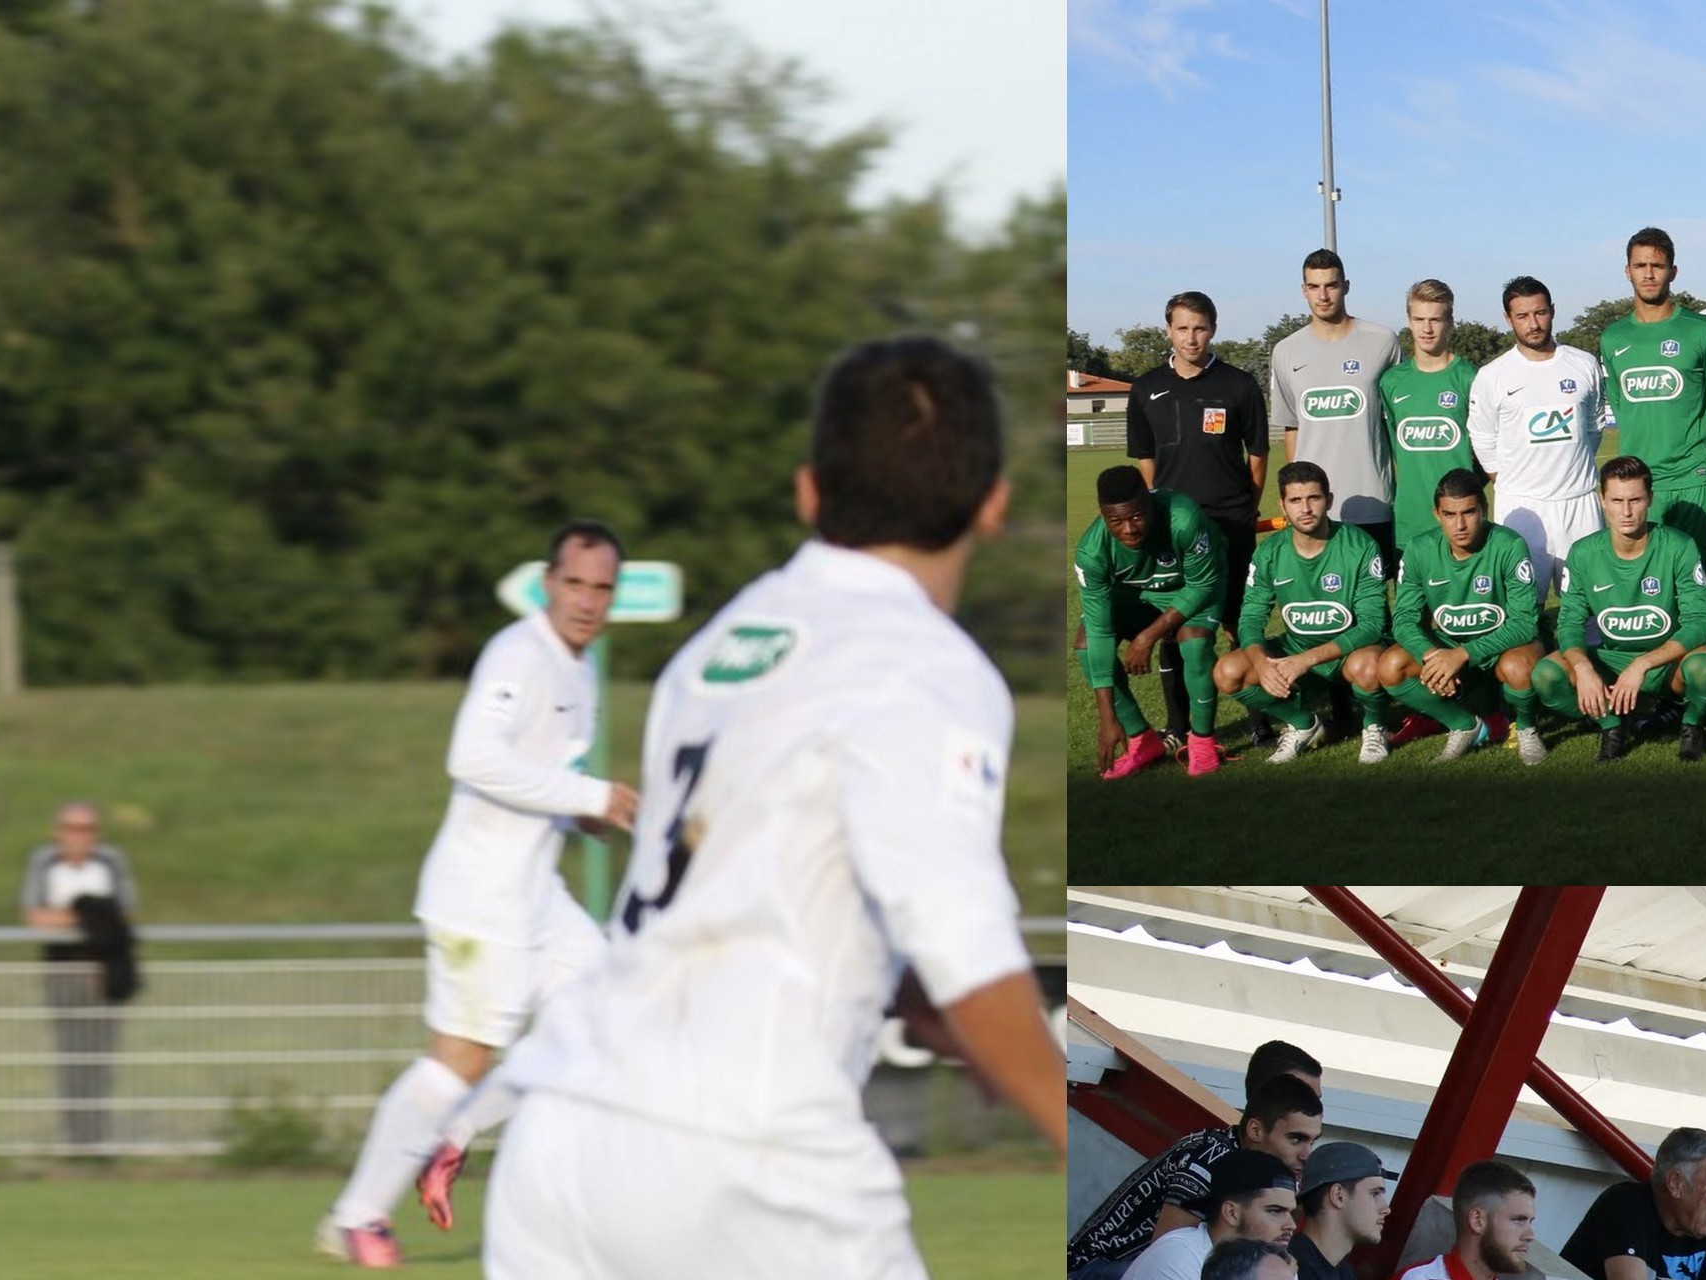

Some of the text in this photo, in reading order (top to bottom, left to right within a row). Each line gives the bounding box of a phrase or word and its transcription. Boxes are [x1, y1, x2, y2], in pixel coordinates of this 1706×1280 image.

[1626, 375, 1659, 392] PMU
[1307, 395, 1343, 411] PMU
[1404, 426, 1435, 440] PMU
[1291, 611, 1325, 625] PMU
[1443, 613, 1476, 627] PMU
[1607, 616, 1643, 631] PMU
